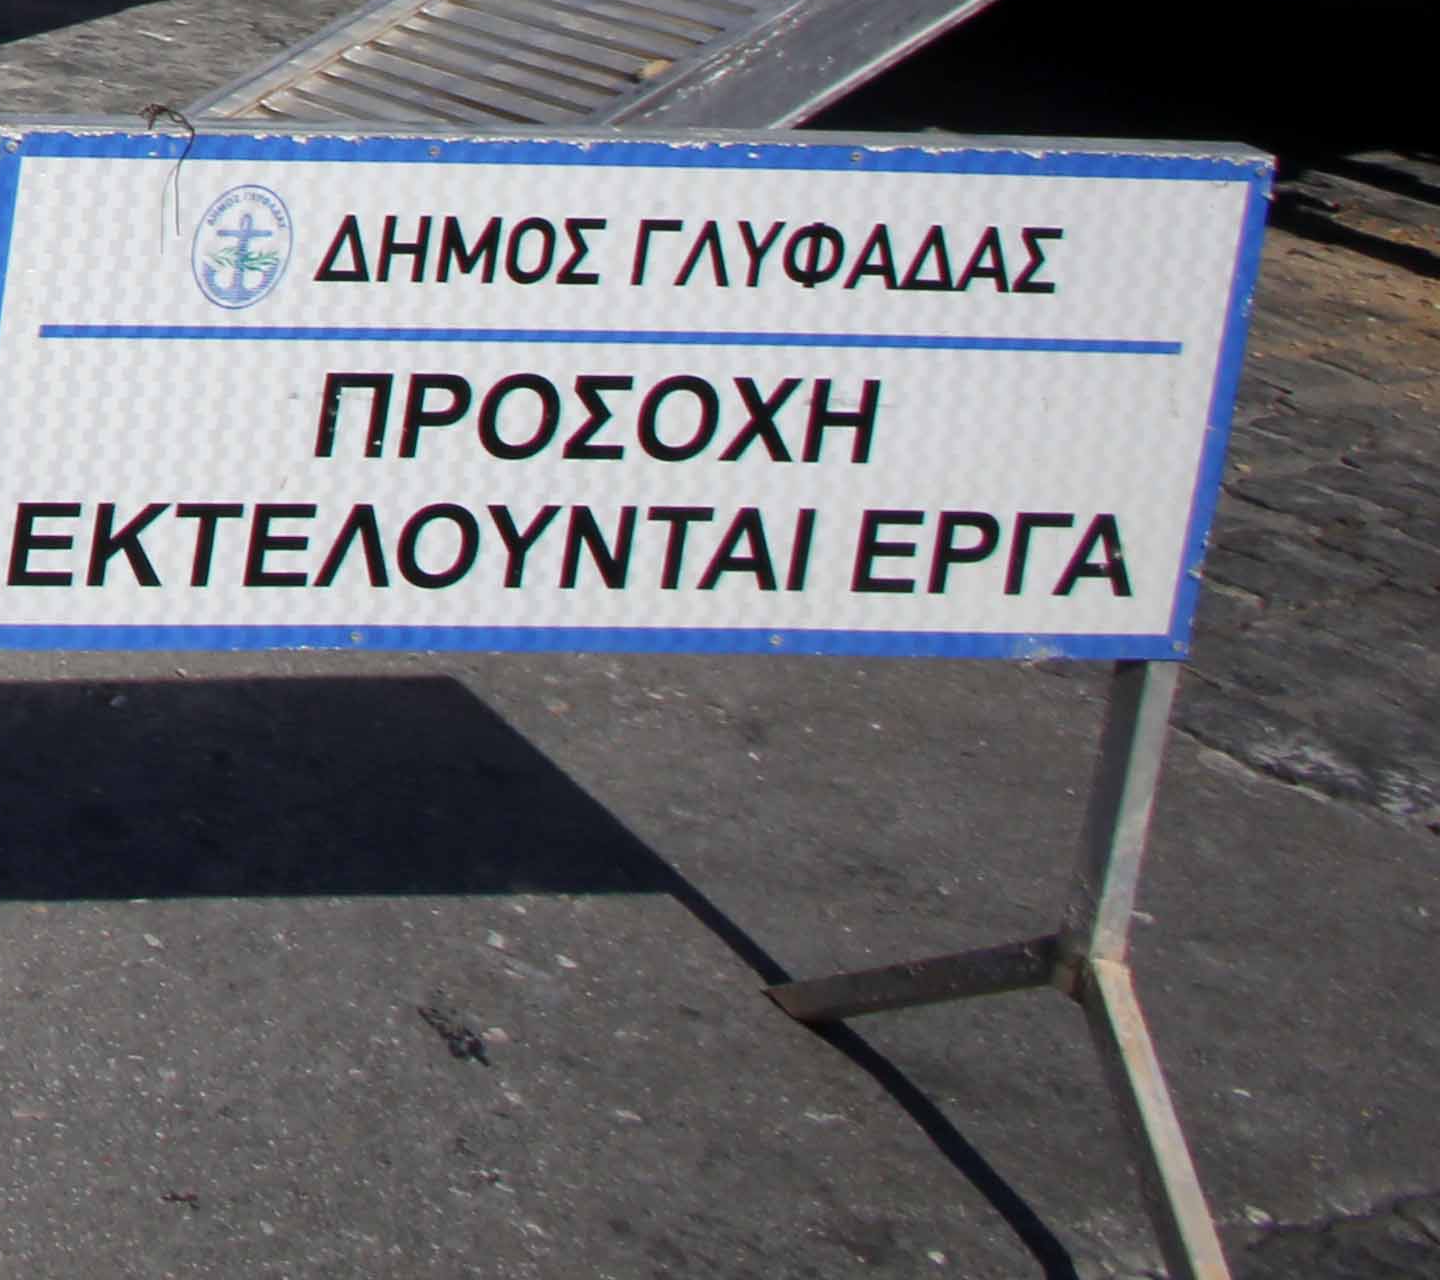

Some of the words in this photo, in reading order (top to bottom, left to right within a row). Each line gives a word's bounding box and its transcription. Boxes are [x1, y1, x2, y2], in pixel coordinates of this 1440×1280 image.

[315, 216, 606, 286] ΔΗΜΟΣ
[630, 220, 1064, 294] ΓΛΥΦΑΔΑΣ
[314, 373, 882, 464] ΠΡΟΣΟΧΗ
[6, 502, 816, 591] ΕΚΤΕΛΟΥΝΤΑΙ
[851, 510, 1133, 597] ΕΡΓΑ
